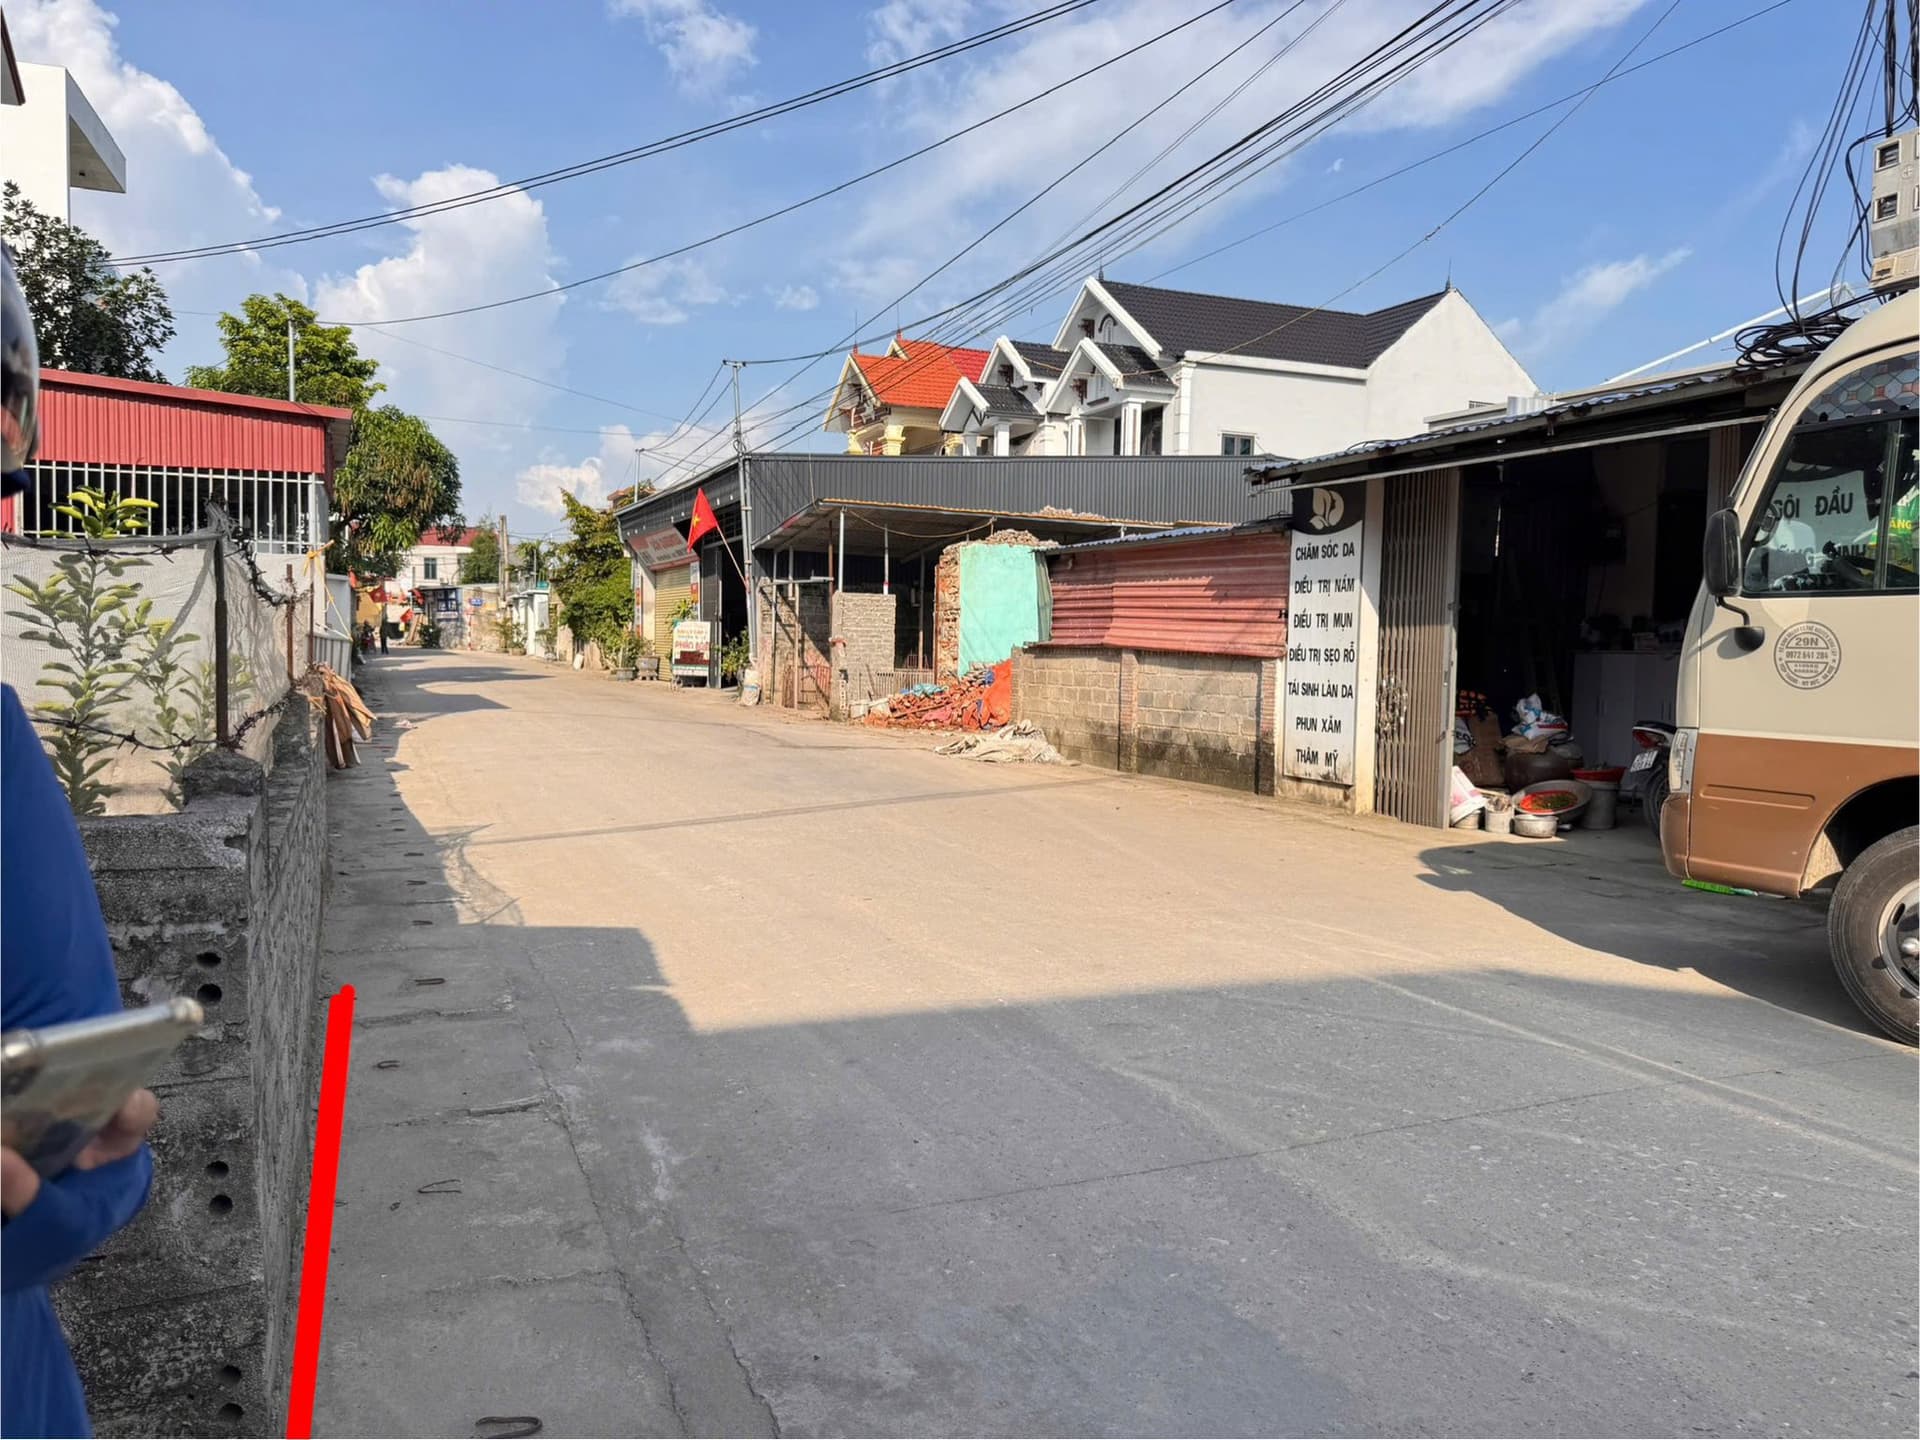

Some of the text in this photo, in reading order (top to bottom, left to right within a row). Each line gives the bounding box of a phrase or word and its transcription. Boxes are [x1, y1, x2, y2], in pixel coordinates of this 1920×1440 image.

[1321, 539, 1339, 559] SÓC
[1342, 542, 1355, 557] DA
[1318, 579, 1331, 597] TRỊ
[1316, 613, 1329, 631] TRỊ
[1333, 612, 1353, 631] MỤN
[1795, 637, 1819, 646] 29N
[1309, 648, 1321, 666] TRỊ
[1323, 648, 1340, 666] SẸO
[1288, 679, 1299, 695] TÁI
[1301, 682, 1319, 697] SINH
[1341, 684, 1354, 699] DA
[1296, 716, 1318, 732] PHUN
